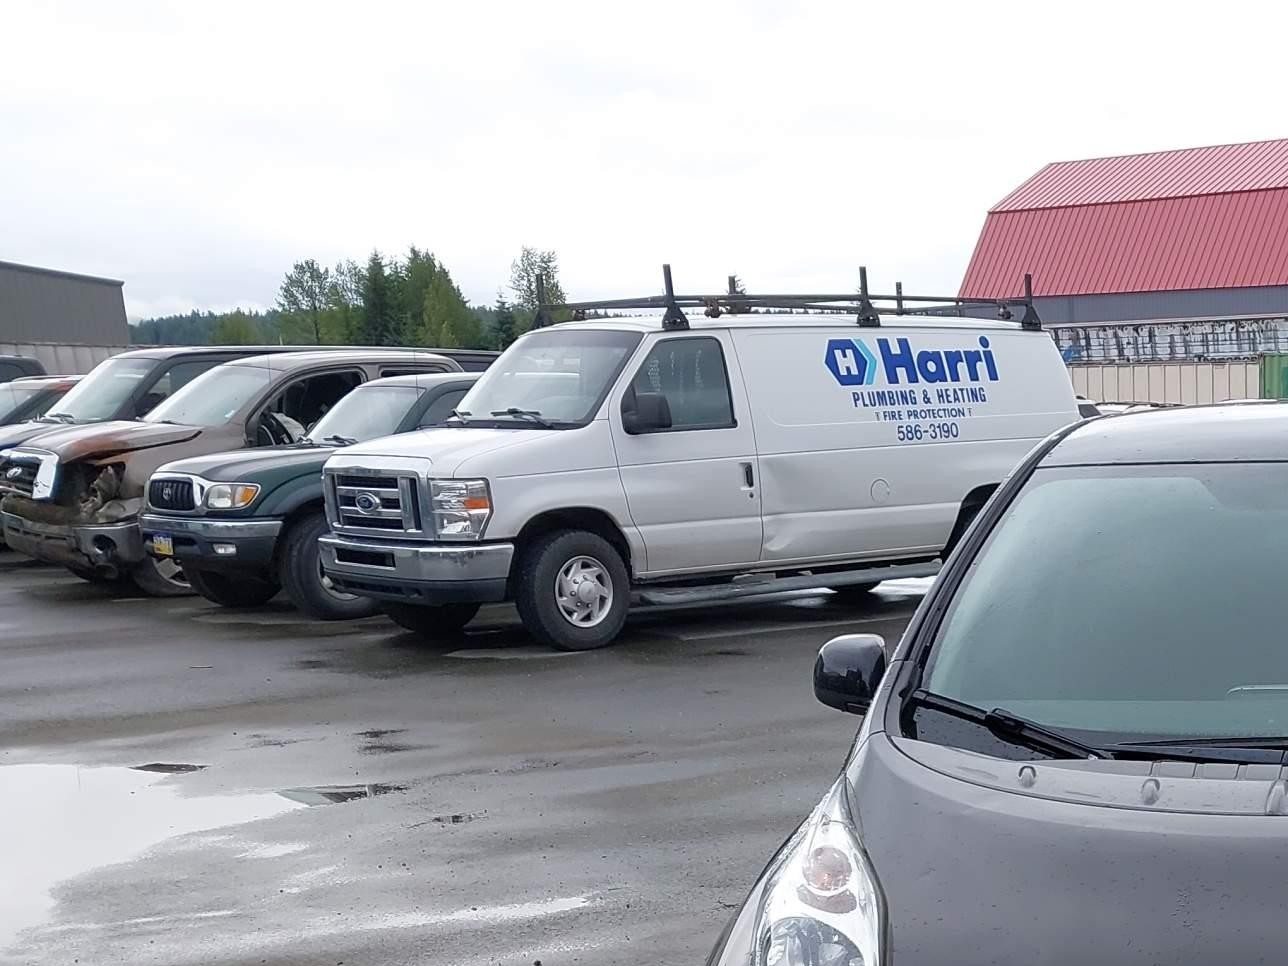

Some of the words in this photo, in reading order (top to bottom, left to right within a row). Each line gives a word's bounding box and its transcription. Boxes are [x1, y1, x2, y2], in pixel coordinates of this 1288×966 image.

[876, 335, 999, 384] Harri
[852, 390, 917, 407] PLUMBING
[922, 388, 932, 404] &
[936, 387, 986, 404] HEATING
[883, 411, 903, 421] FIRE
[907, 407, 965, 420] PROTECTION
[897, 422, 959, 441] 586-3190
